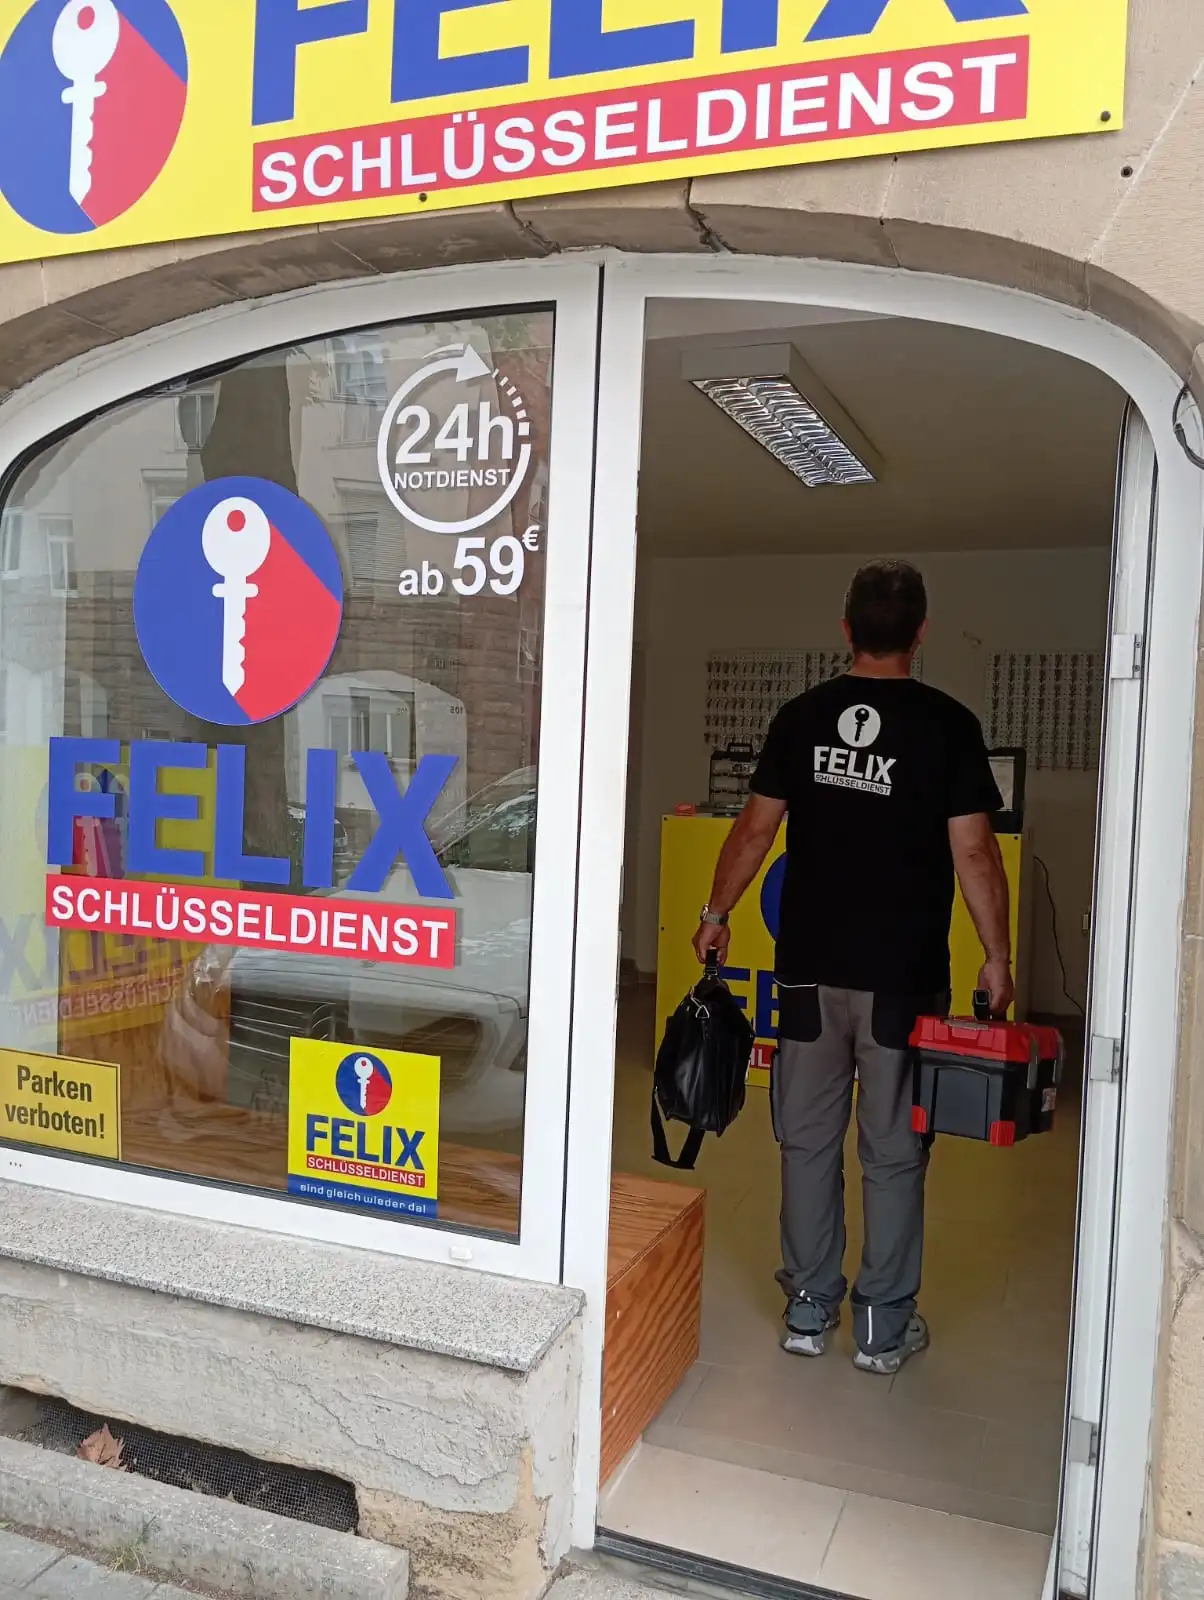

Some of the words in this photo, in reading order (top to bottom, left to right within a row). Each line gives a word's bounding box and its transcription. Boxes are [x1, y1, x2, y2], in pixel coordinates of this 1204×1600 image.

[259, 52, 1018, 203] SCHLÜSSELDIENST
[395, 401, 514, 465] 24h
[393, 468, 512, 489] NOTDIENST
[398, 561, 444, 596] ab
[814, 745, 897, 785] FELIX
[47, 737, 459, 899] FELIX
[52, 885, 449, 959] SCHLÜSSELDIENST
[17, 1064, 93, 1102] Parken
[4, 1102, 105, 1139] verboten!
[306, 1113, 426, 1171] FELIX
[307, 1157, 424, 1186] SCHLÜSSELDIENST
[300, 1183, 324, 1195] sind
[326, 1187, 361, 1202] gleich
[363, 1195, 406, 1209] wieder
